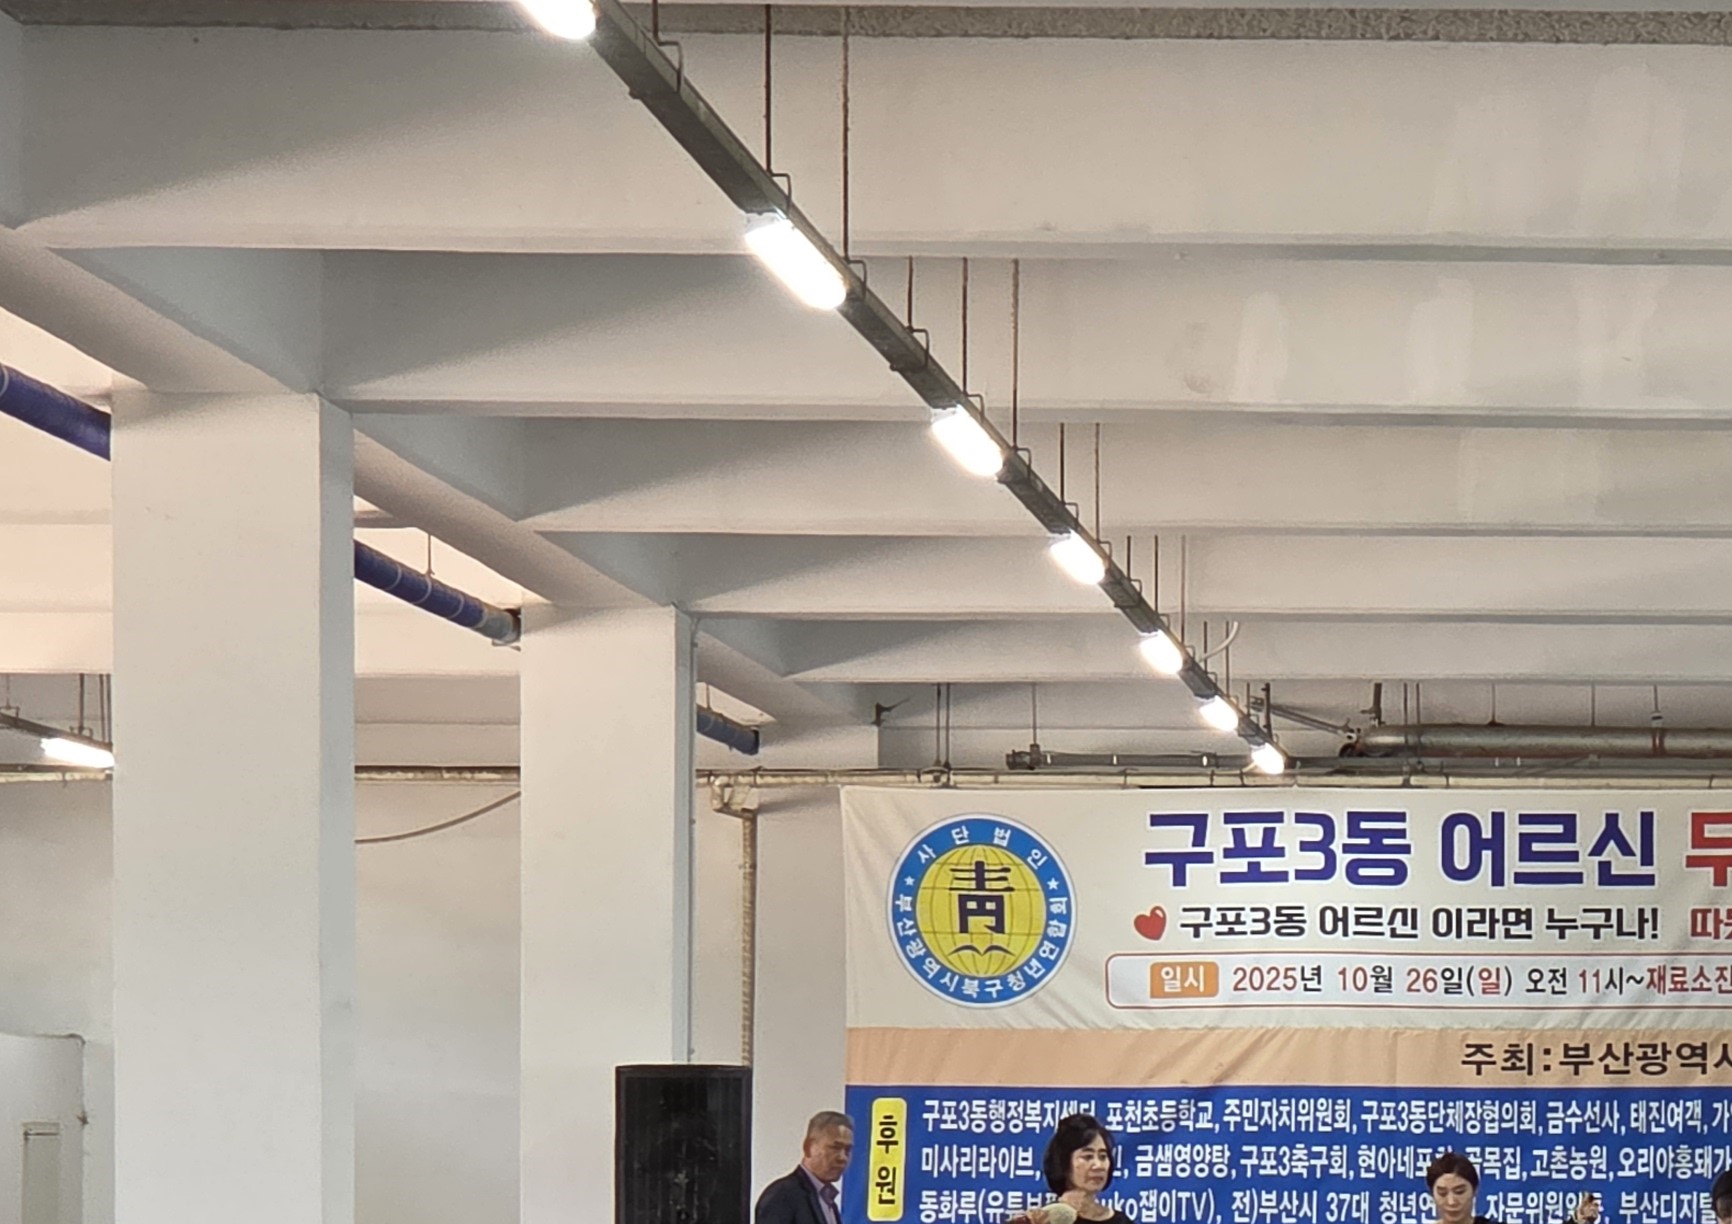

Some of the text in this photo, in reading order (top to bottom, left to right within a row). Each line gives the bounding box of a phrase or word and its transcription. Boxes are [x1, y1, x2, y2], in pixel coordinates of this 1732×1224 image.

[1144, 810, 1412, 888] 구포3동
[1441, 810, 1656, 888] 어르신
[1179, 905, 1308, 939] 구포3동
[1318, 905, 1419, 940] 어르신
[1431, 907, 1534, 940] 이라면
[1545, 906, 1659, 941] 누구나!
[1161, 966, 1204, 992] 일시
[1232, 964, 1323, 993] 2025년
[1337, 964, 1393, 994] 10월
[1406, 965, 1513, 997] 26일(일)
[1525, 966, 1568, 996] 오전
[1104, 1098, 1220, 1133] 포천초등학교,
[1222, 1097, 1357, 1135] 주민자치위원회,
[1360, 1099, 1543, 1135] 구포3동단체장협의회,
[1546, 1100, 1626, 1135] 금수선사,
[1630, 1099, 1708, 1134] 태진여객,
[874, 1114, 899, 1205] 후원
[921, 1144, 1041, 1181] 미사리라이브,
[1135, 1143, 1237, 1179] 금샘영양탕,
[1239, 1143, 1355, 1180] 구포3축구회,
[1357, 1144, 1455, 1181] 현아네포
[1530, 1145, 1614, 1182] 고촌농원,
[1231, 1188, 1318, 1224] 전)부산시
[1325, 1191, 1370, 1224] 37대
